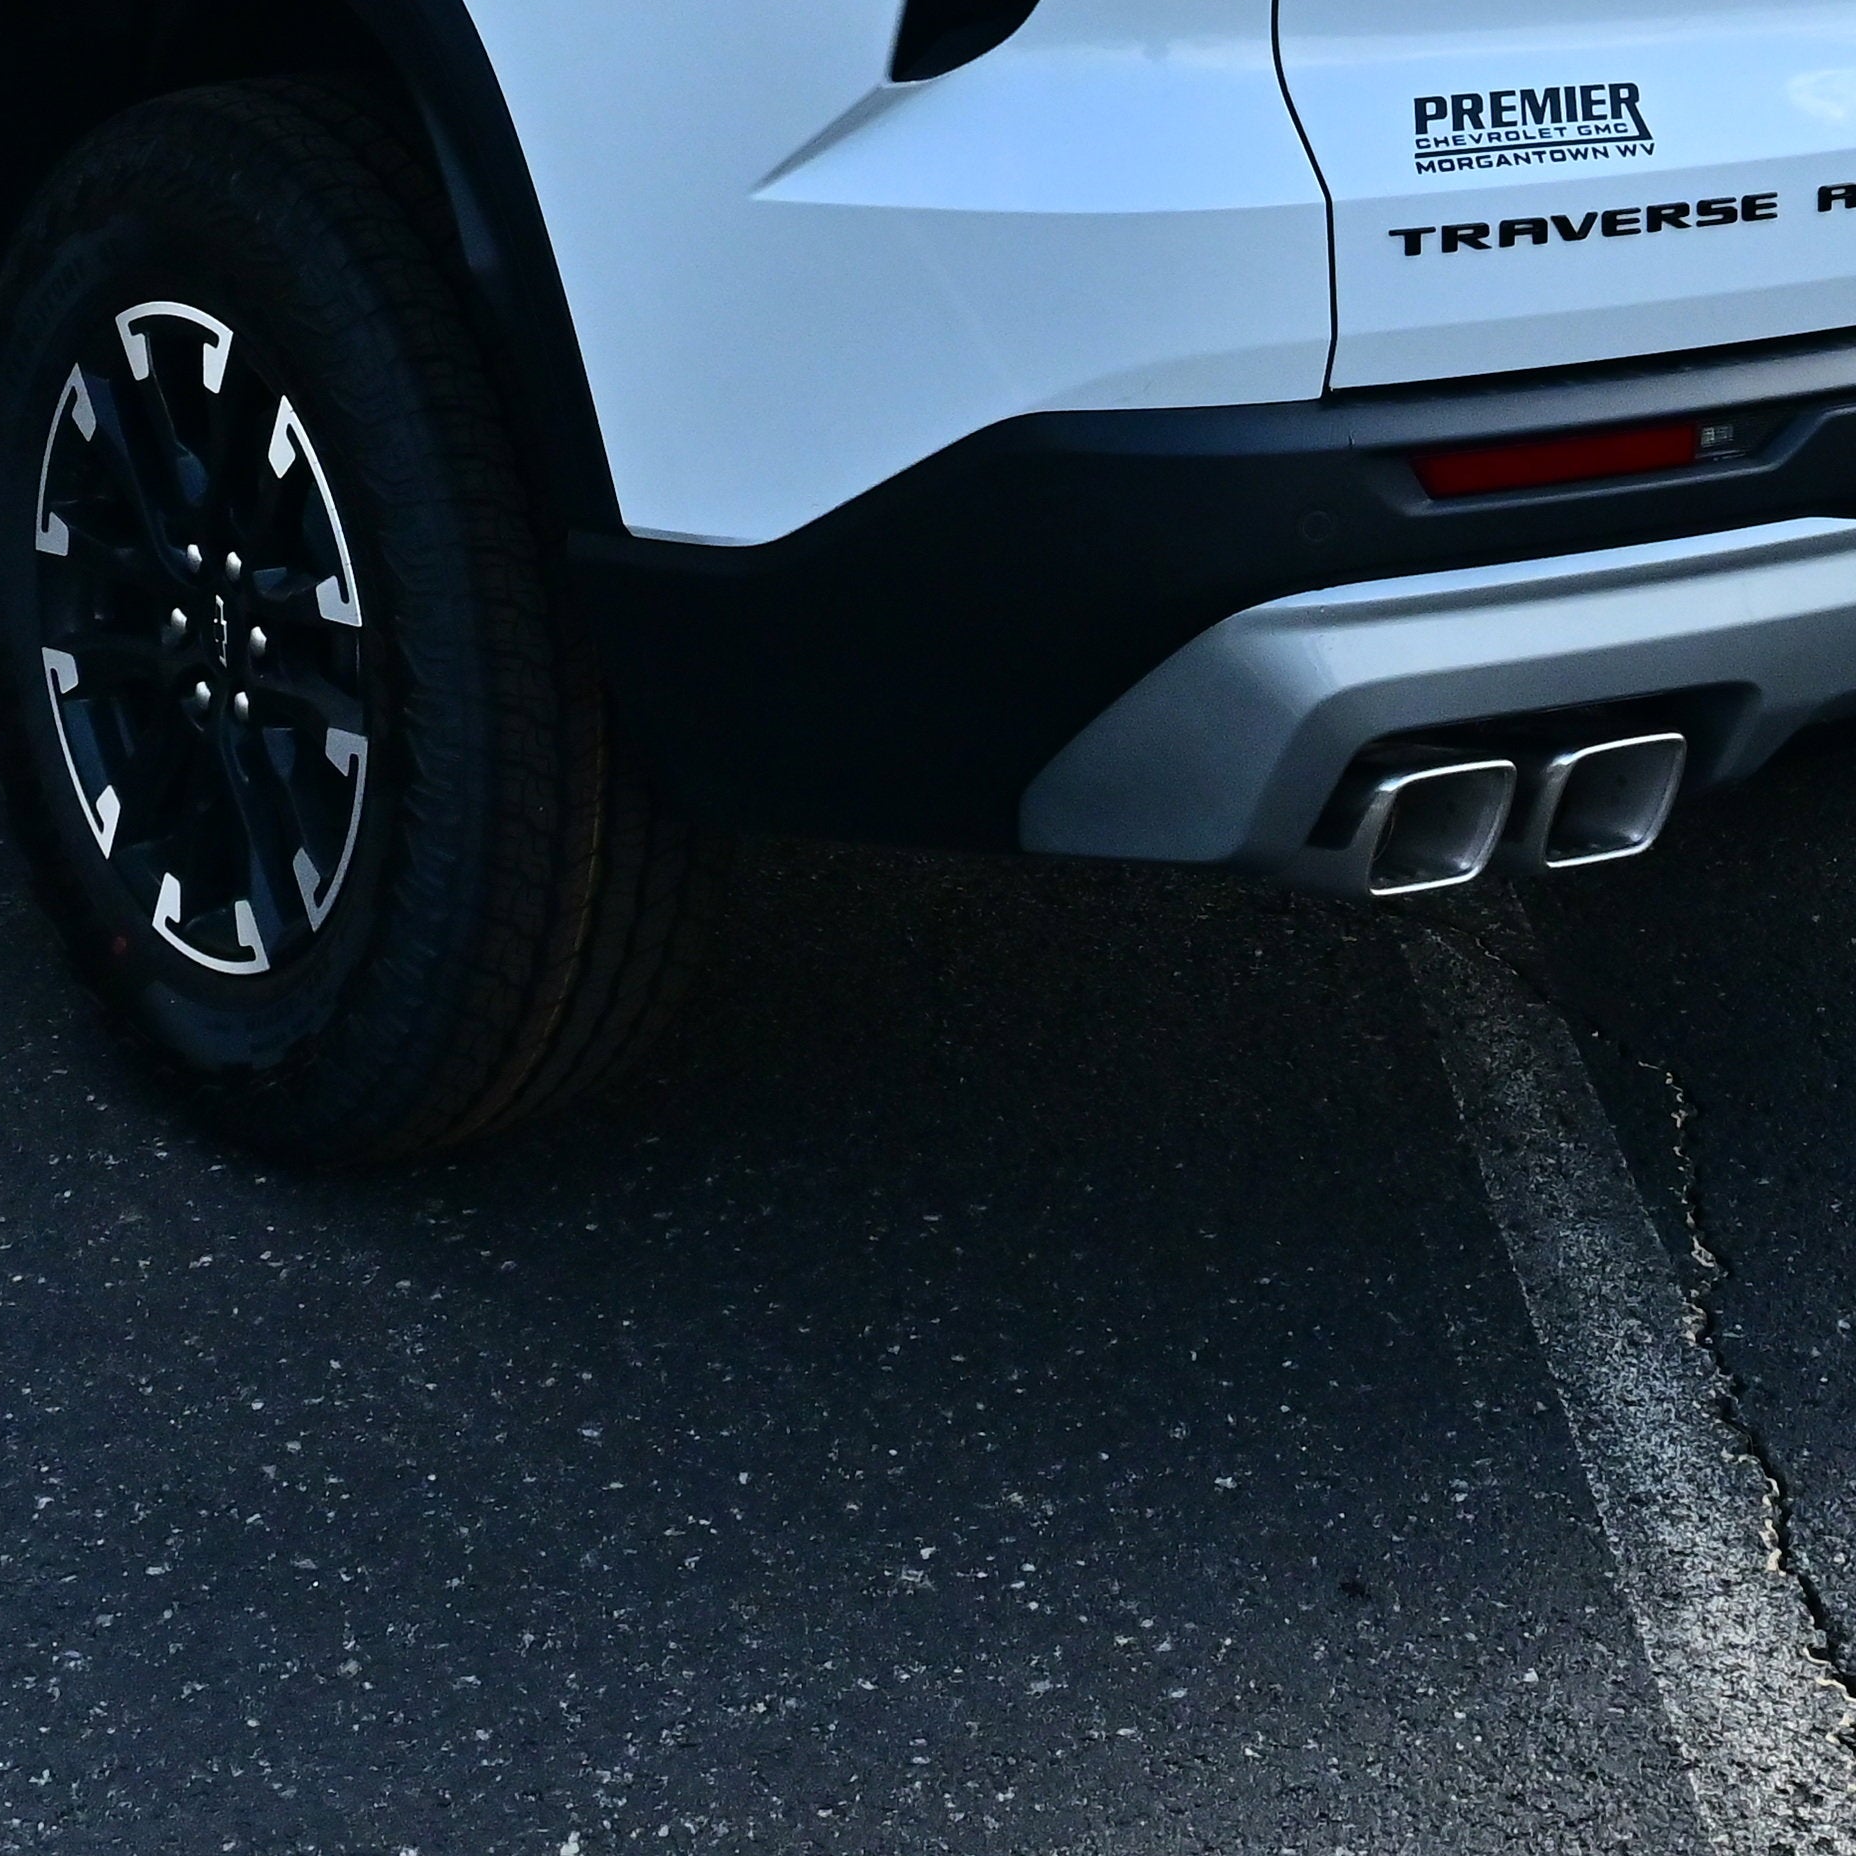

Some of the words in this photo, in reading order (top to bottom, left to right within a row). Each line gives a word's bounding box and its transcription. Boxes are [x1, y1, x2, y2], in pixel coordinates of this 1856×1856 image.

[1413, 82, 1653, 136] PREMIER
[1415, 126, 1567, 150] CHEVROLET
[1576, 122, 1629, 136] GMC
[1415, 145, 1609, 175] MORGANTOWN
[1615, 142, 1655, 158] WV
[1388, 191, 1779, 257] TRAVERSE
